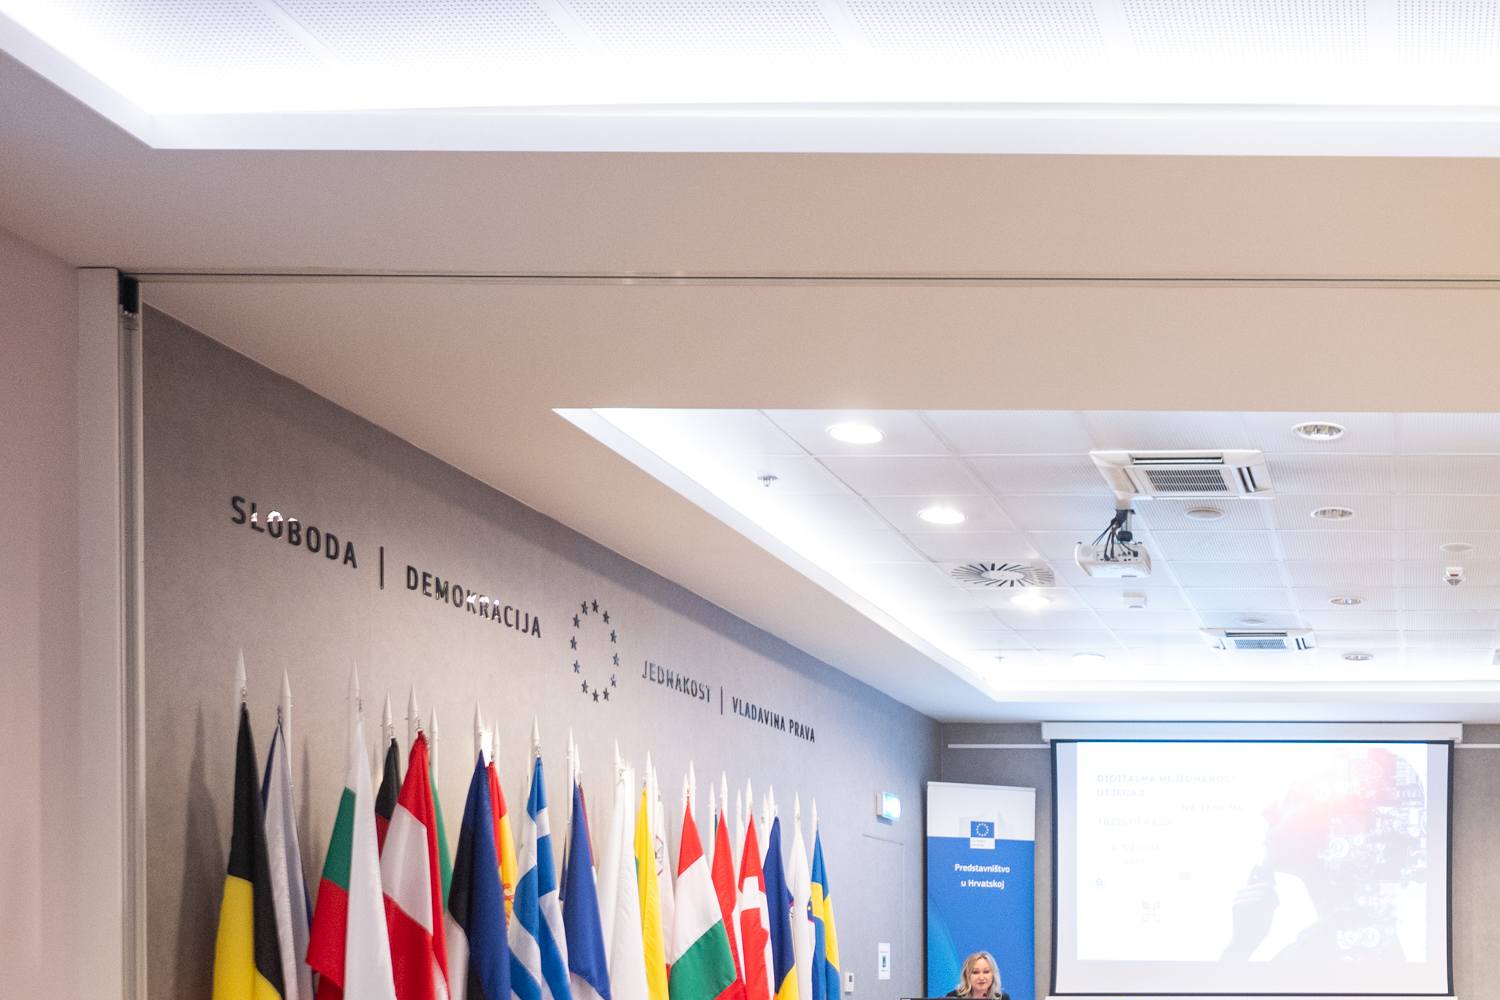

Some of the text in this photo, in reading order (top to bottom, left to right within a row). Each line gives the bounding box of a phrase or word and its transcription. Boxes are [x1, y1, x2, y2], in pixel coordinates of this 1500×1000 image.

[231, 495, 541, 639] SLOBODA DEMOKRACIJA
[641, 660, 816, 743] JEDNAKOST VLADAVINA PRAVA
[954, 864, 1011, 873] Predstavništvo
[968, 880, 1005, 890] Hrvatskoj
